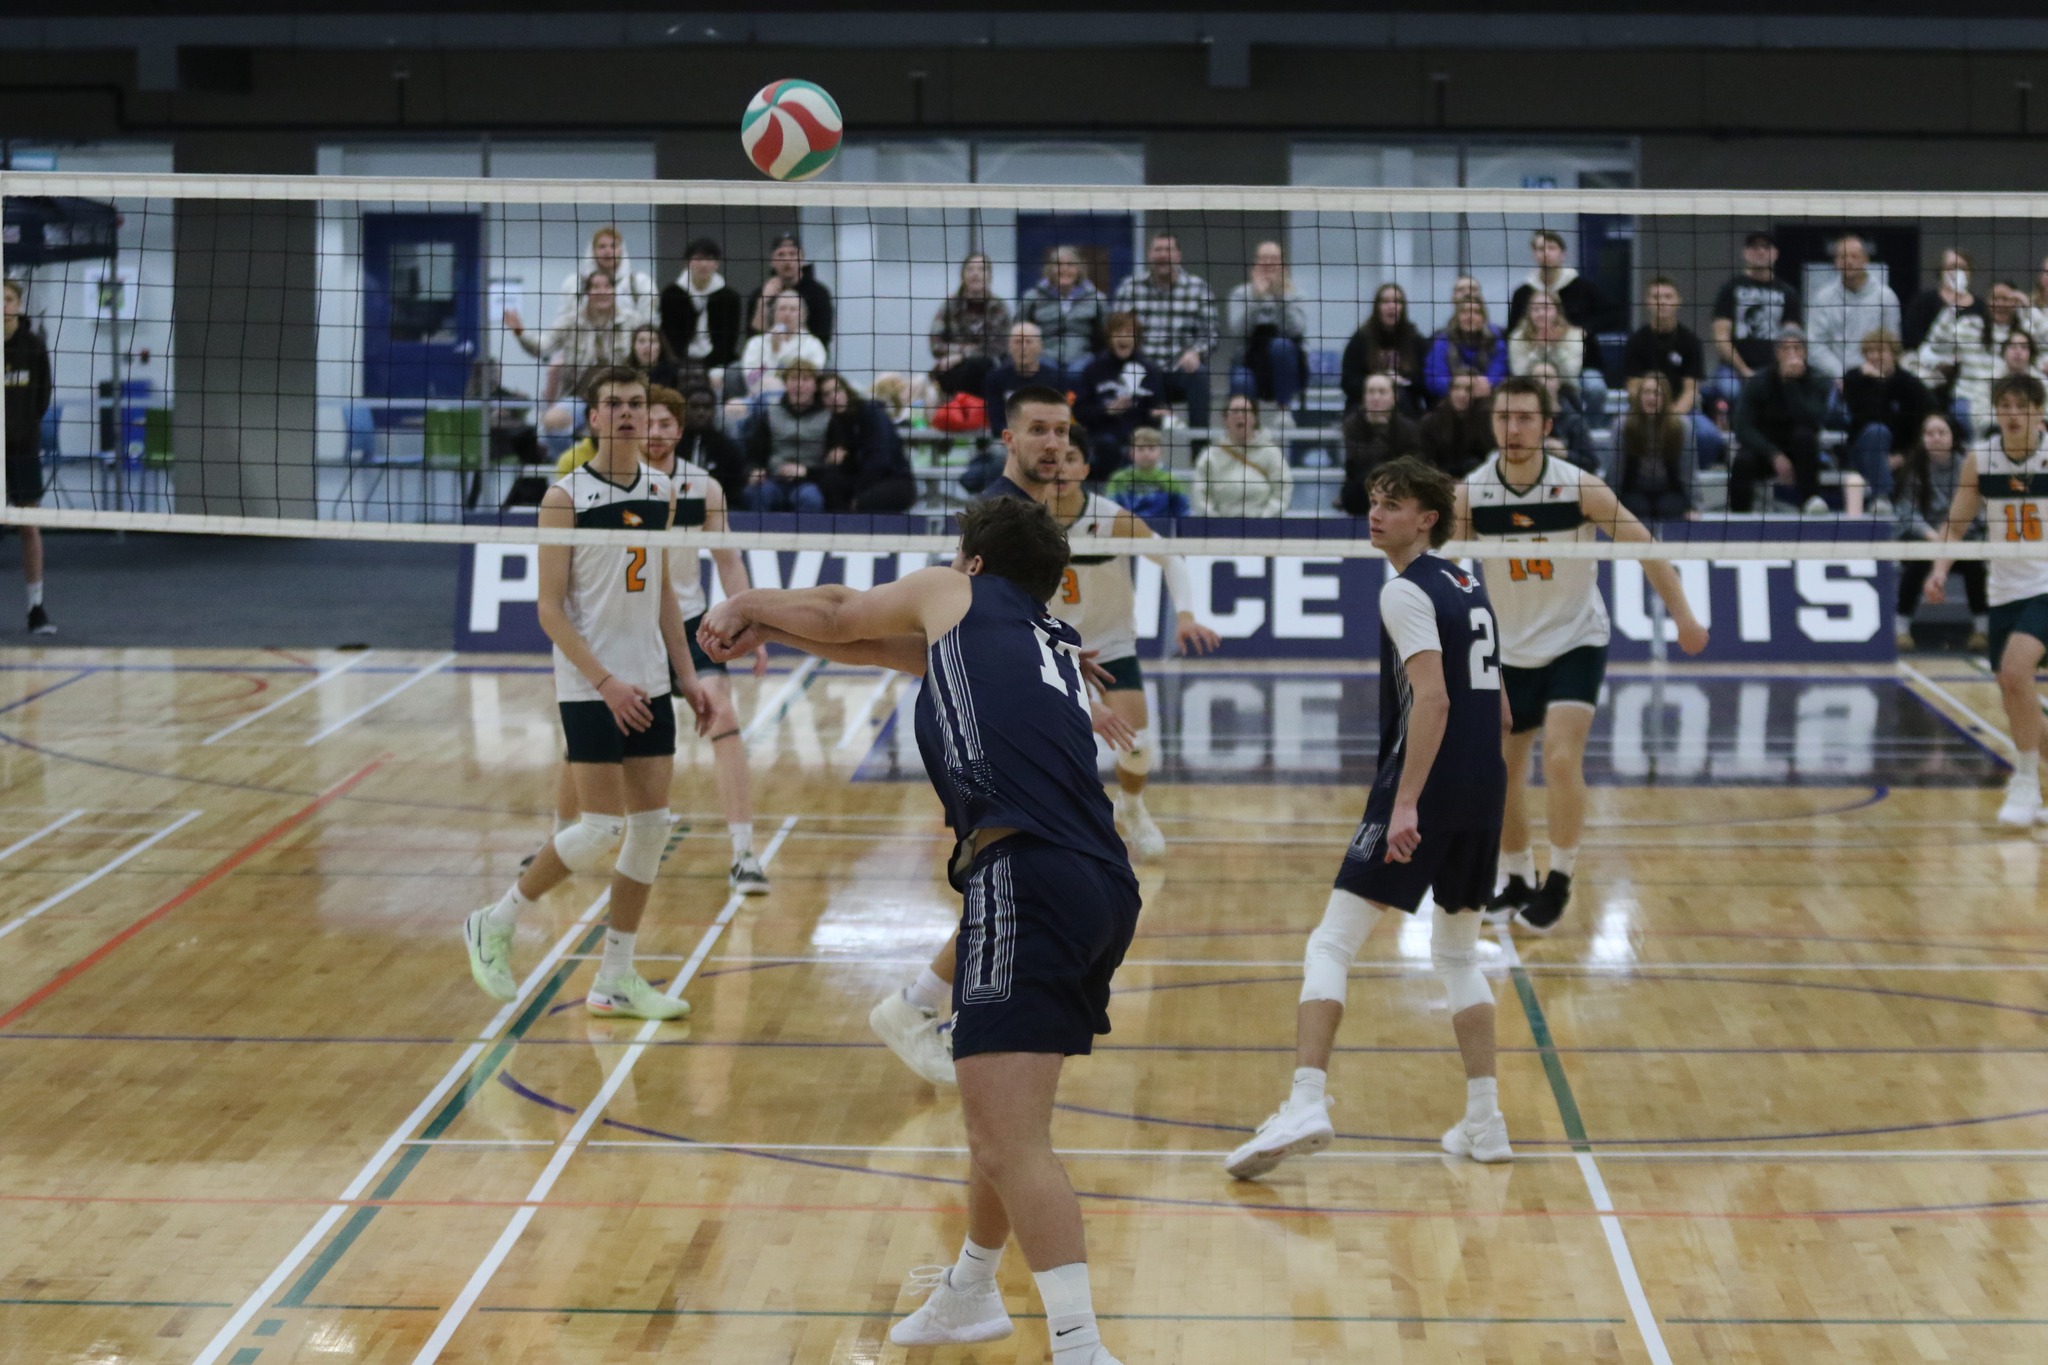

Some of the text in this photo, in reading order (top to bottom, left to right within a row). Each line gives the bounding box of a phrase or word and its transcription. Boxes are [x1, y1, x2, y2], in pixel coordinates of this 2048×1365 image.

[2003, 503, 2044, 542] 16
[626, 545, 647, 592] 2
[1028, 619, 1092, 721] 17
[1470, 607, 1501, 690] 2
